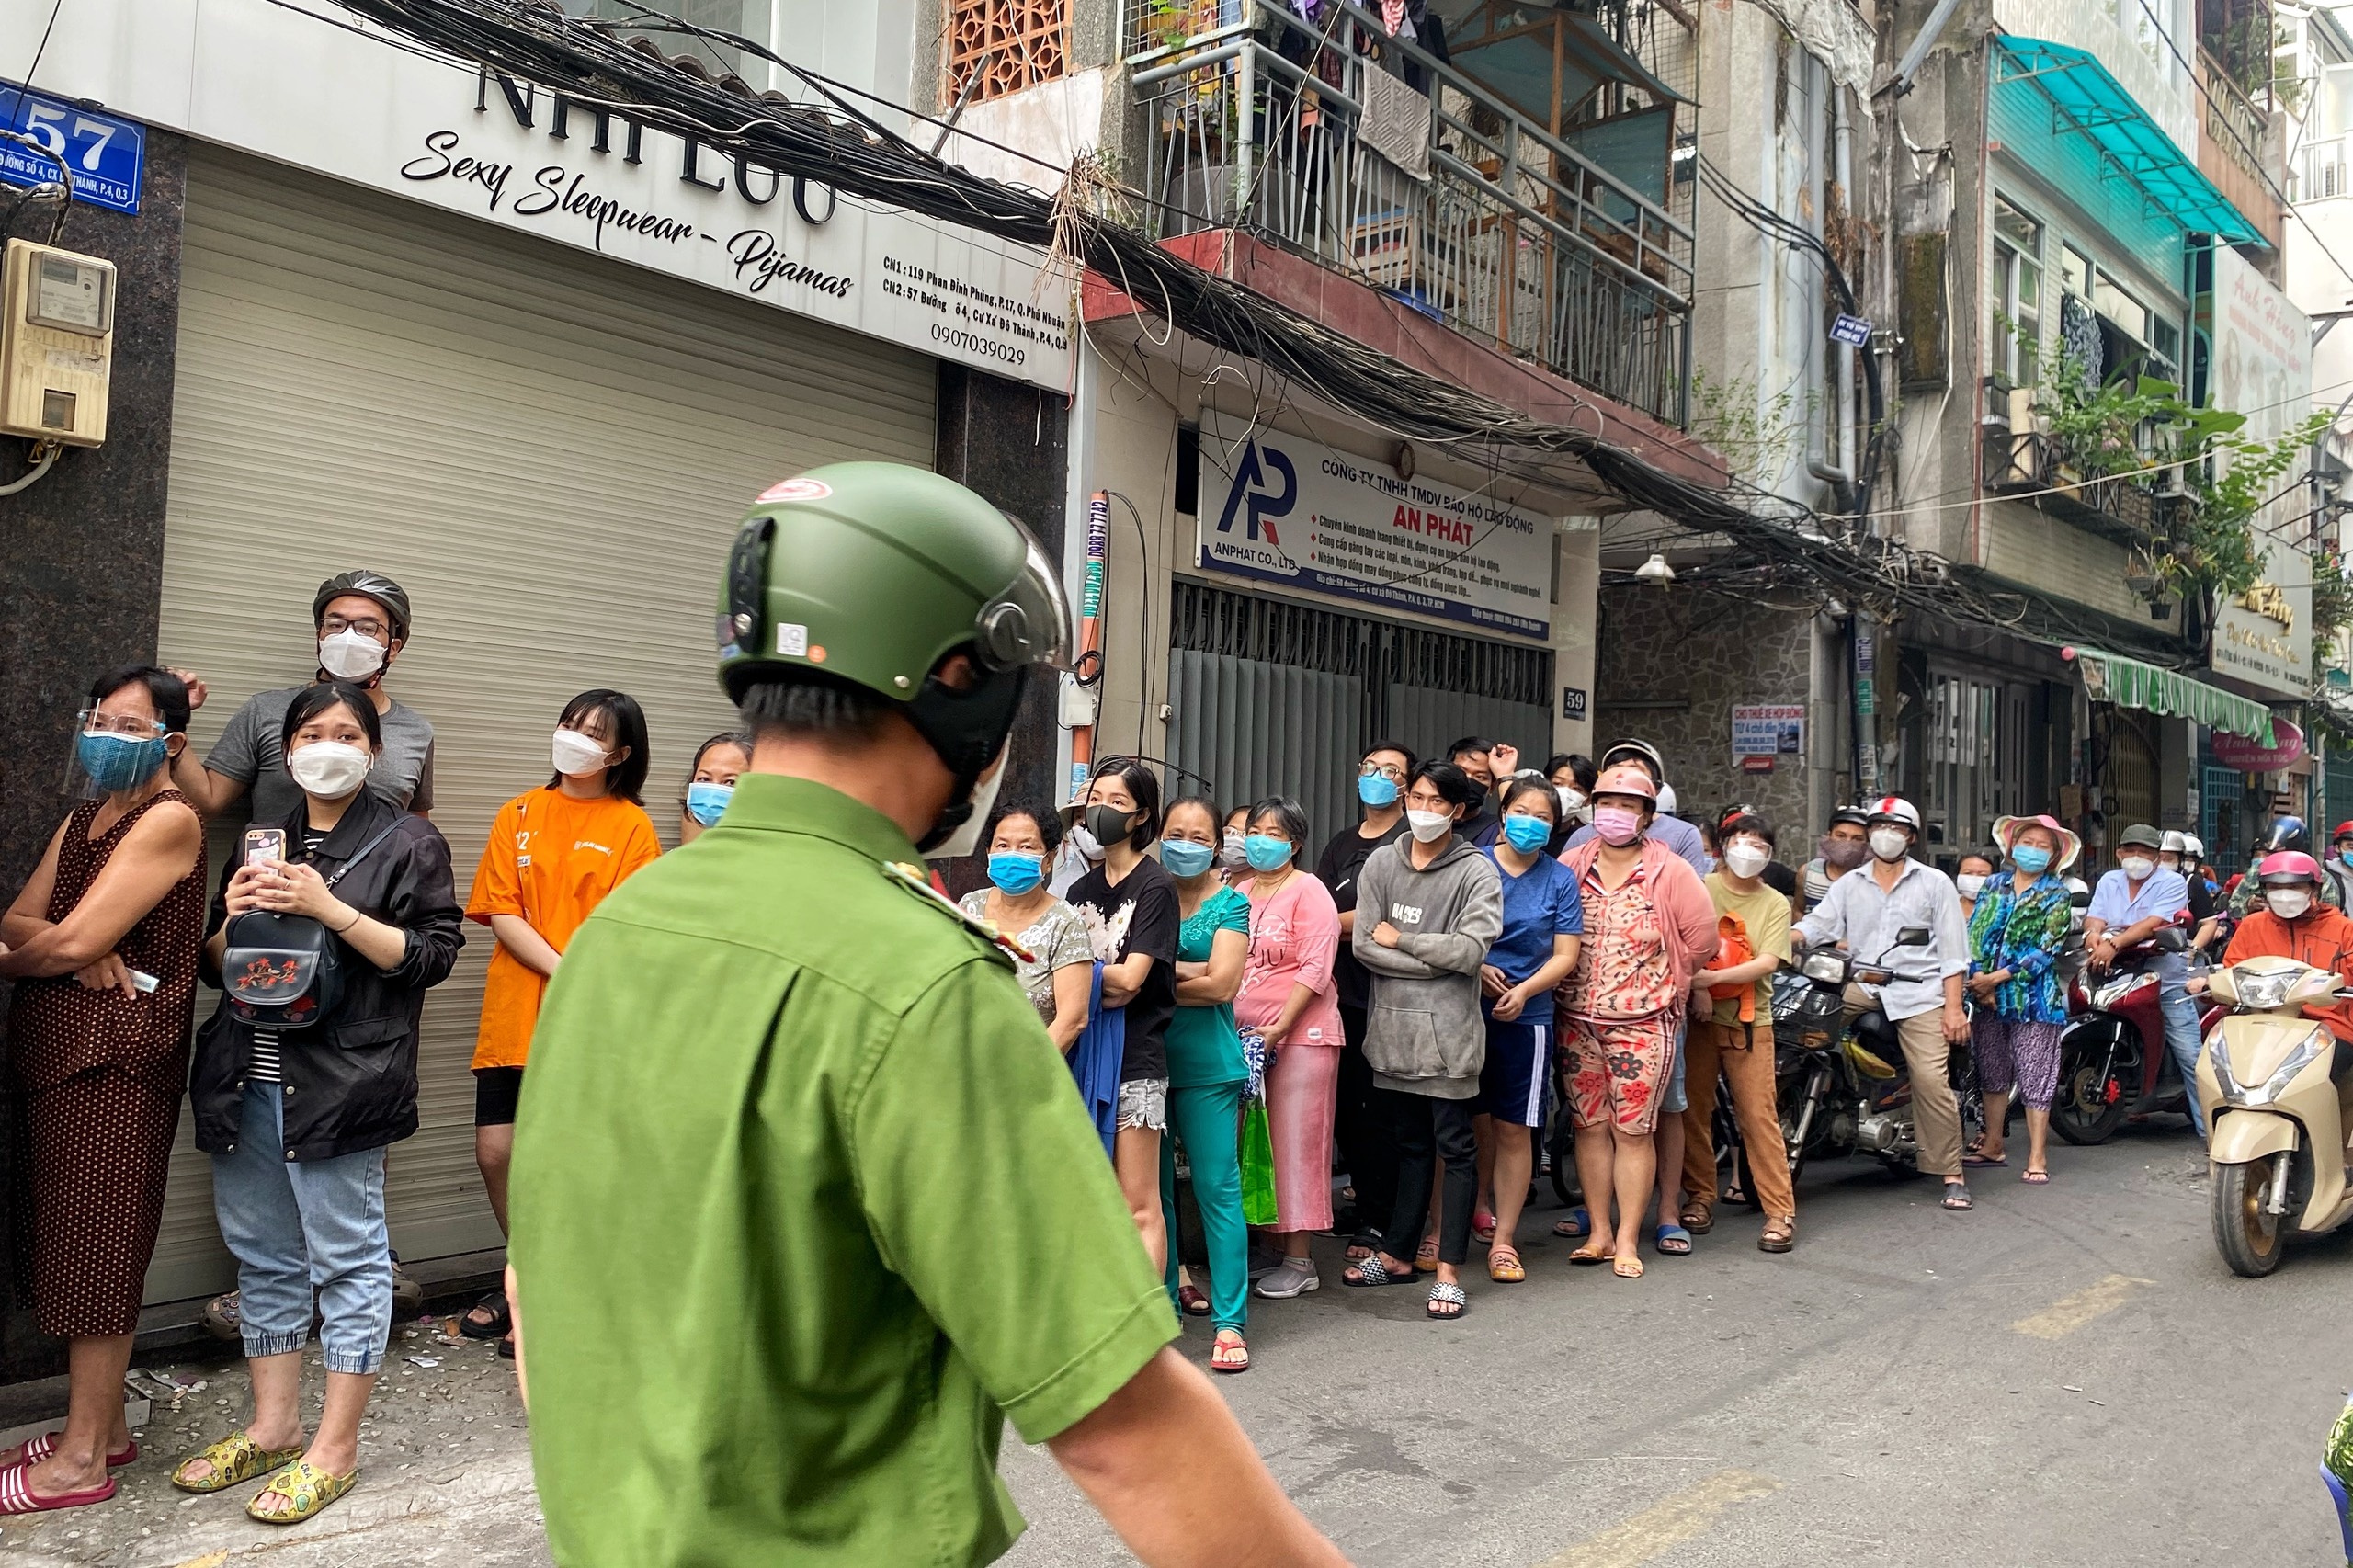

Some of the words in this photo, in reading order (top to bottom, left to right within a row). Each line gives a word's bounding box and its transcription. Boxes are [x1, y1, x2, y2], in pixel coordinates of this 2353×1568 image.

[25, 102, 116, 171] 57
[26, 159, 36, 175] SỐ
[38, 165, 45, 179] 4,
[47, 167, 58, 181] CX
[73, 174, 99, 195] THÀNH,
[99, 185, 114, 199] P.4,
[115, 187, 128, 200] Q.3
[401, 131, 511, 211] Sexy
[513, 166, 694, 250] Sleepwear
[726, 229, 855, 299] Pijamas
[921, 290, 947, 313] Đường
[999, 317, 1010, 332] Đô
[926, 270, 948, 290] Phan
[949, 278, 968, 297] Đình
[1041, 311, 1065, 331] Nhuận
[931, 324, 1025, 365] 0907039029
[1322, 459, 1357, 483] CÔNG
[1360, 470, 1375, 484] TY
[1377, 475, 1408, 497] TNHH
[1411, 485, 1441, 506] TMDV
[1468, 503, 1483, 523] HỘ
[1485, 508, 1504, 525] LAO
[1506, 515, 1534, 535] ĐỘNG
[1319, 515, 1342, 531] Chuyên
[1393, 504, 1421, 533] AN
[1427, 513, 1473, 547] PHÁT
[1215, 542, 1256, 563] ANPHAT
[1257, 551, 1278, 568] CO.,
[1279, 555, 1296, 571] LTD
[1318, 551, 1335, 567] Nhận
[1364, 563, 1377, 576] may
[1319, 533, 1334, 549] Cung
[1336, 537, 1347, 551] cấp
[1364, 544, 1374, 558] tay
[1374, 547, 1386, 560] các
[1567, 691, 1584, 710] 59
